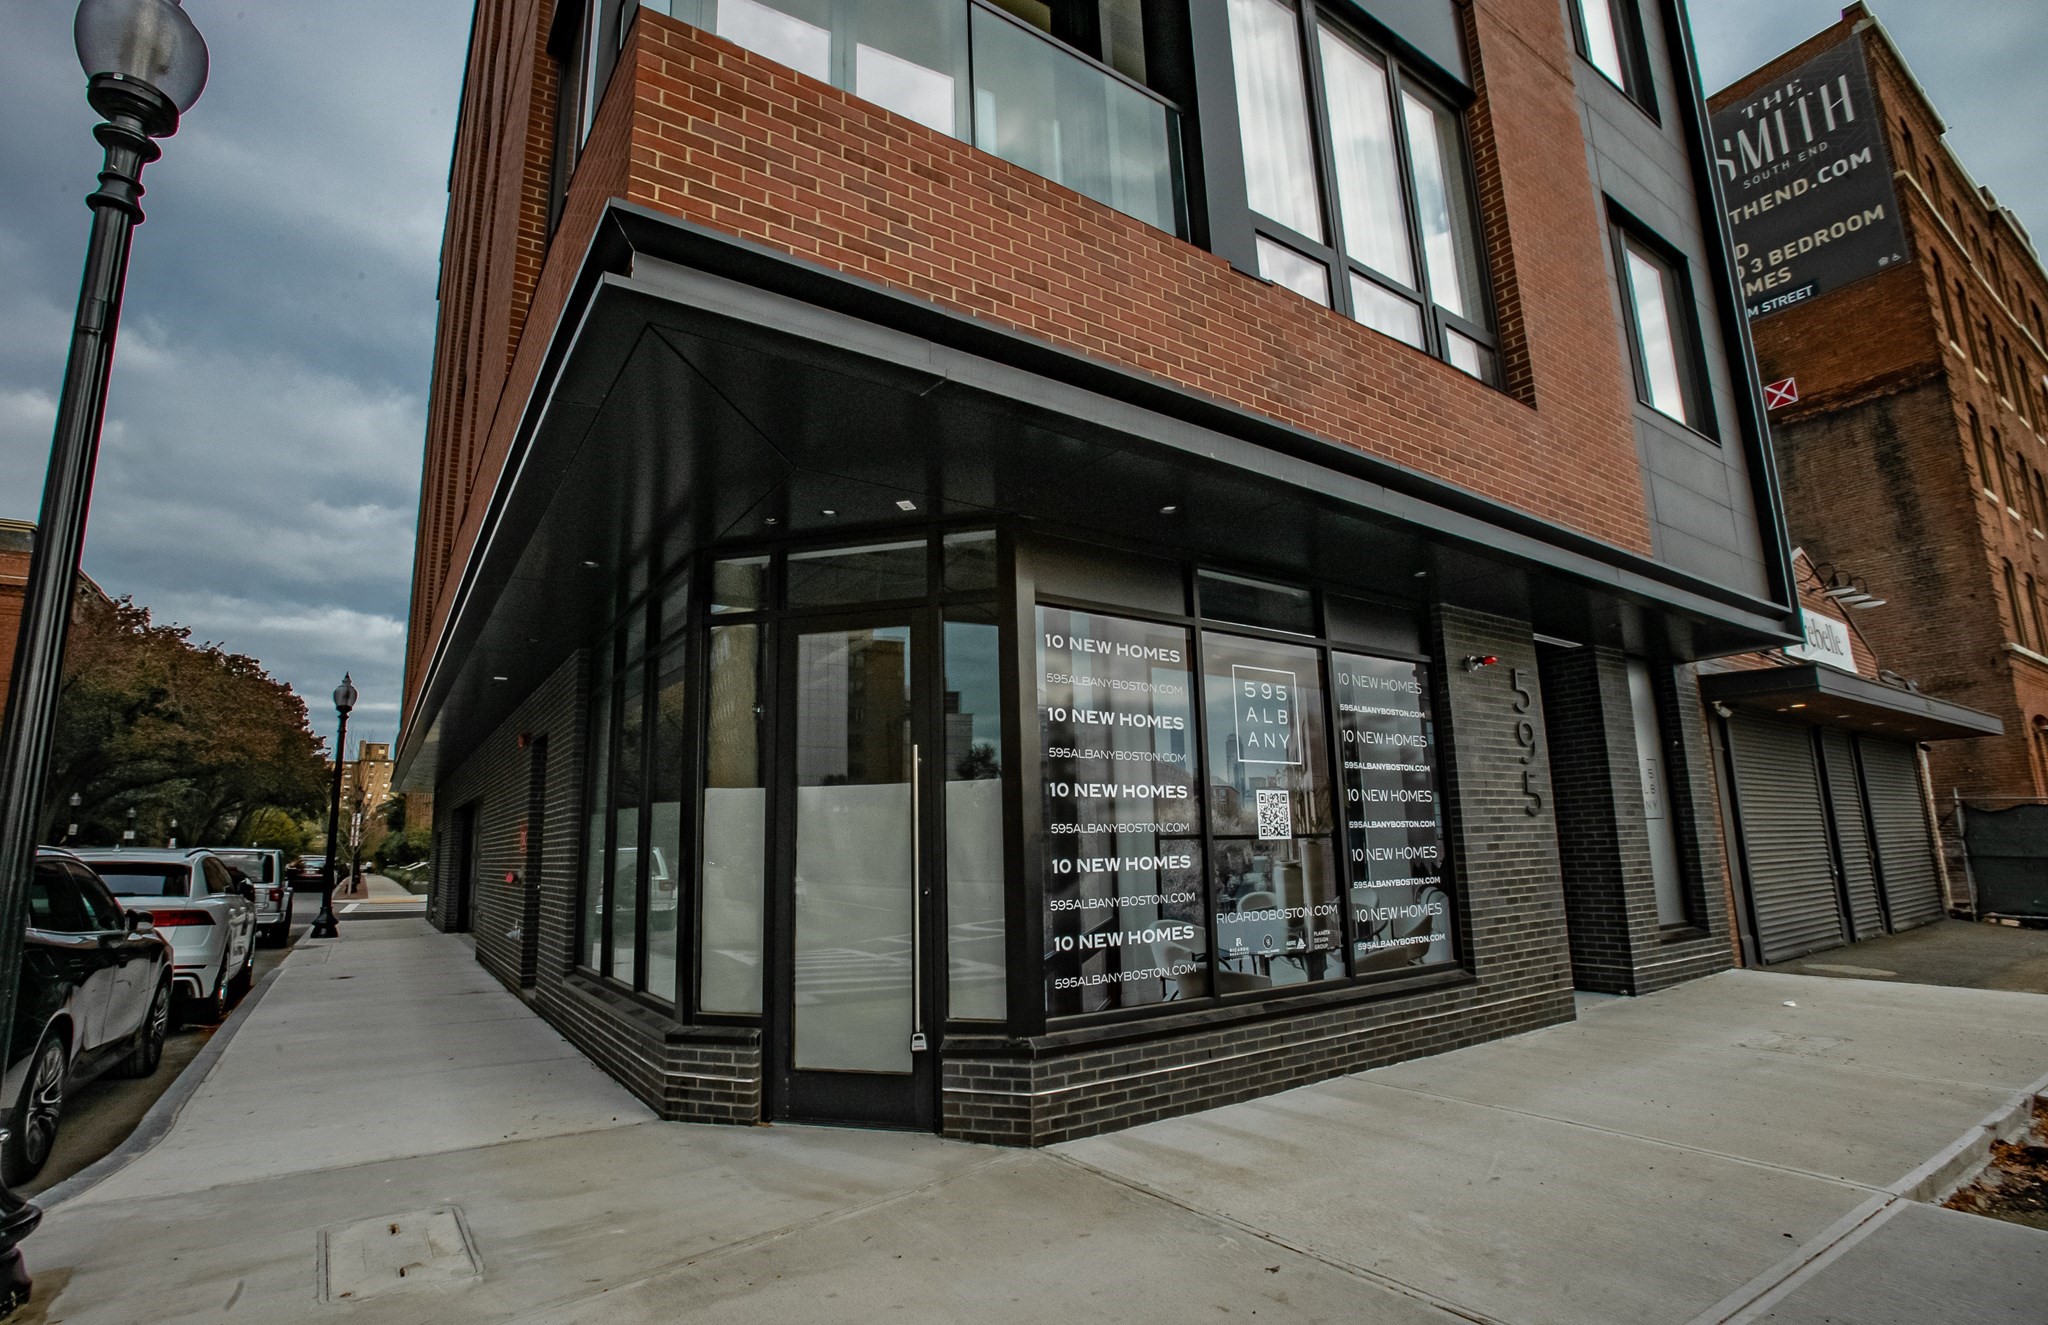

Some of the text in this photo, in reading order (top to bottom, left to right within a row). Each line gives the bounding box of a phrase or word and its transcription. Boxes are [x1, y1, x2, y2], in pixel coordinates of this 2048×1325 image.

[1741, 78, 1802, 119] THE
[1743, 141, 1828, 189] SOUTH END
[1751, 204, 1885, 273] 3 BEDROOM
[1744, 266, 1792, 297] MES
[1761, 284, 1814, 314] STREET
[1804, 618, 1844, 656] ebelle
[1045, 634, 1180, 663] 10 NEW HOMES
[1047, 673, 1182, 695] 595ALBANYBOSTON.COM
[1244, 682, 1287, 701] 595
[1338, 673, 1422, 695] 10 NEW HOMES
[1048, 707, 1184, 730] 10 NEW HOMES
[1246, 707, 1288, 725] ALB
[1340, 704, 1425, 718] 595ALBANYBOSTON.COM
[1248, 732, 1289, 750] ANY
[1343, 730, 1427, 748] 10 NEW HOMES
[1512, 668, 1542, 818] 595
[1049, 748, 1186, 763] 595ALBANYBOSTON.COM
[1345, 761, 1430, 772] 595ALBANYBOSTON.COM
[1050, 783, 1187, 799] 10 NEW HOMES
[1347, 789, 1432, 802] 10 NEW HOMES
[1051, 823, 1190, 834] 595ALBANYBOSTON.COM
[1349, 820, 1435, 828] 595ALBANYBOSTON.COM
[1352, 846, 1437, 862] 10 NEW HOMES
[1052, 855, 1191, 874] 10 NEW HOMES
[1354, 877, 1440, 889] 595ALBANYBOSTON.COM
[1050, 893, 1195, 911] 595ALBANYBOSTON.COM
[1216, 904, 1338, 925] RICARDOBOSTON.COM
[1356, 903, 1442, 922] 10 NEW HOMES
[1054, 926, 1194, 951] 10 NEW HOMES
[1357, 934, 1445, 951] 595ALBANYBOSTON.COM
[1055, 964, 1197, 989] 595ALBANYBOSTON.COM
